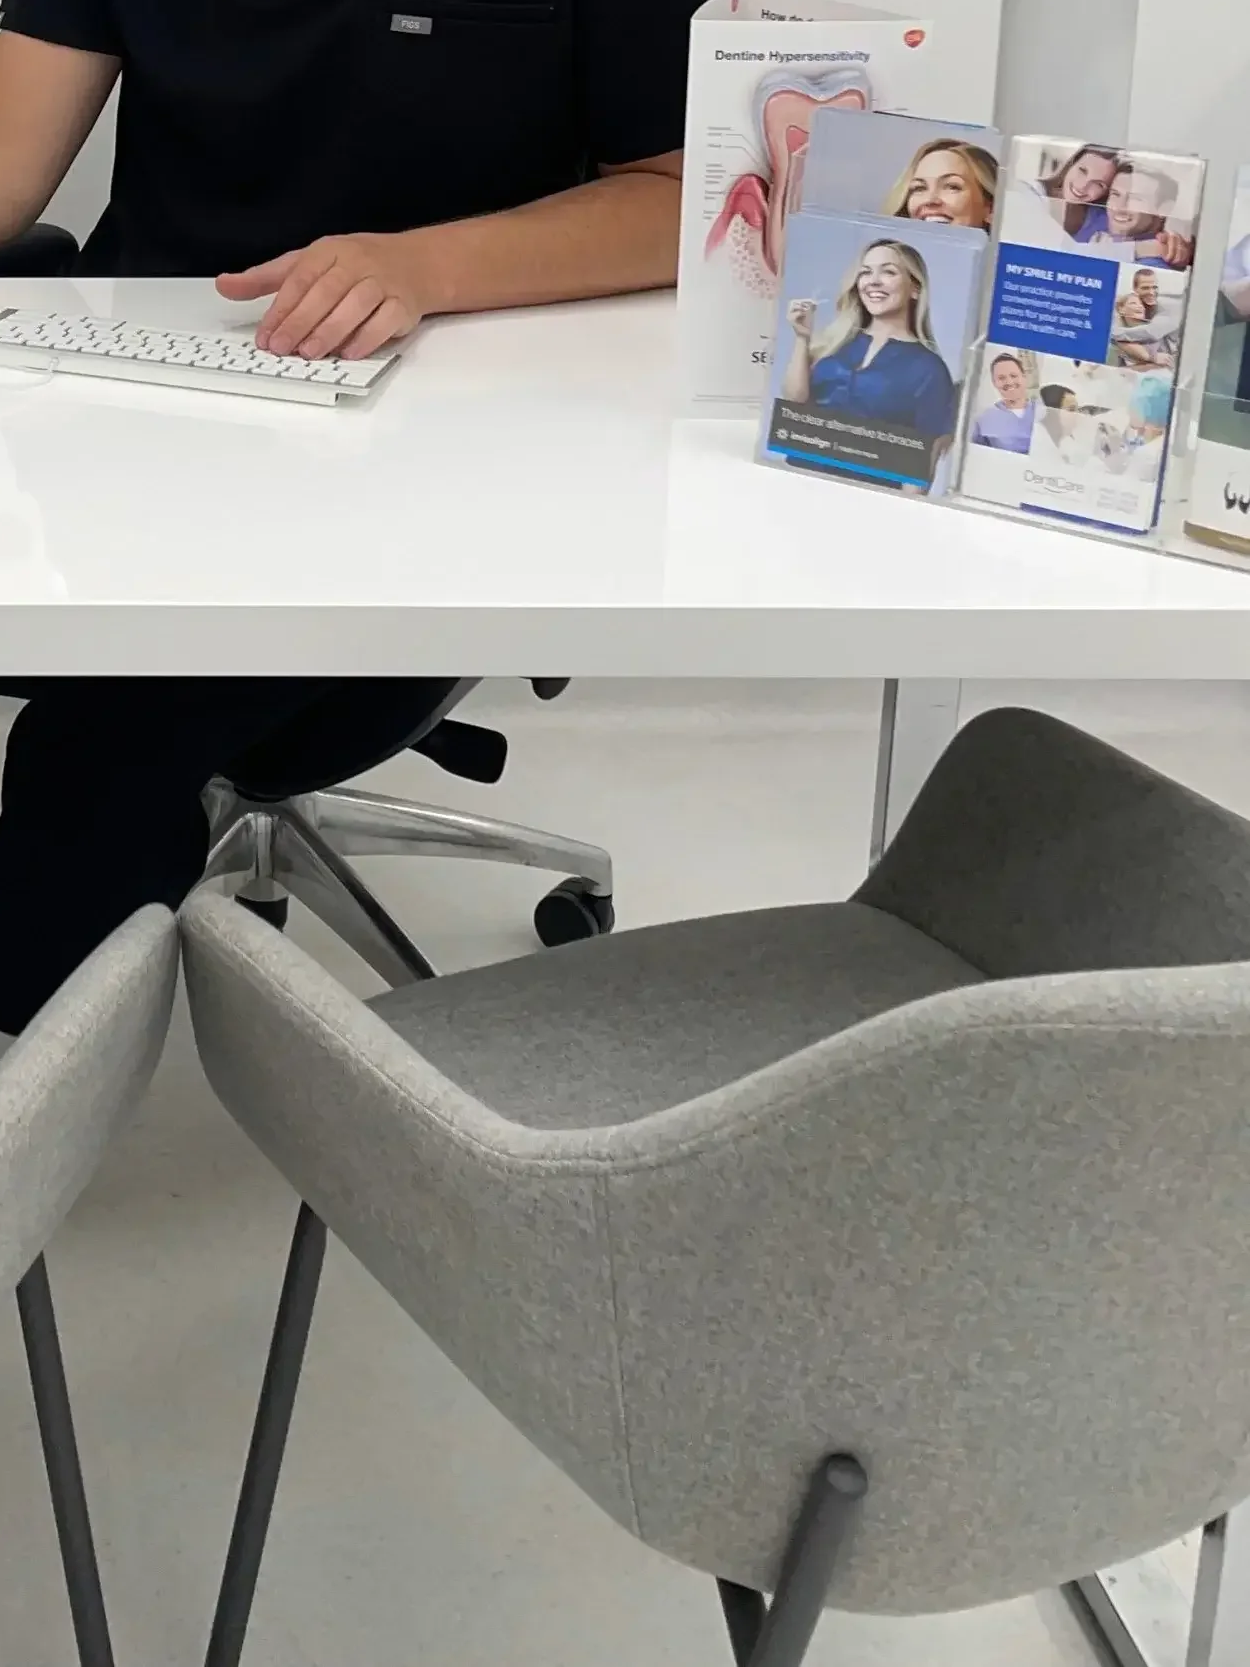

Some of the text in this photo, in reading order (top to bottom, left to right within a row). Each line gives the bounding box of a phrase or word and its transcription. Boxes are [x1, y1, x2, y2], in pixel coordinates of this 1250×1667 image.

[762, 9, 785, 22] How
[401, 20, 420, 29] FIGS
[715, 50, 870, 64] Dentine Hypersensitivity
